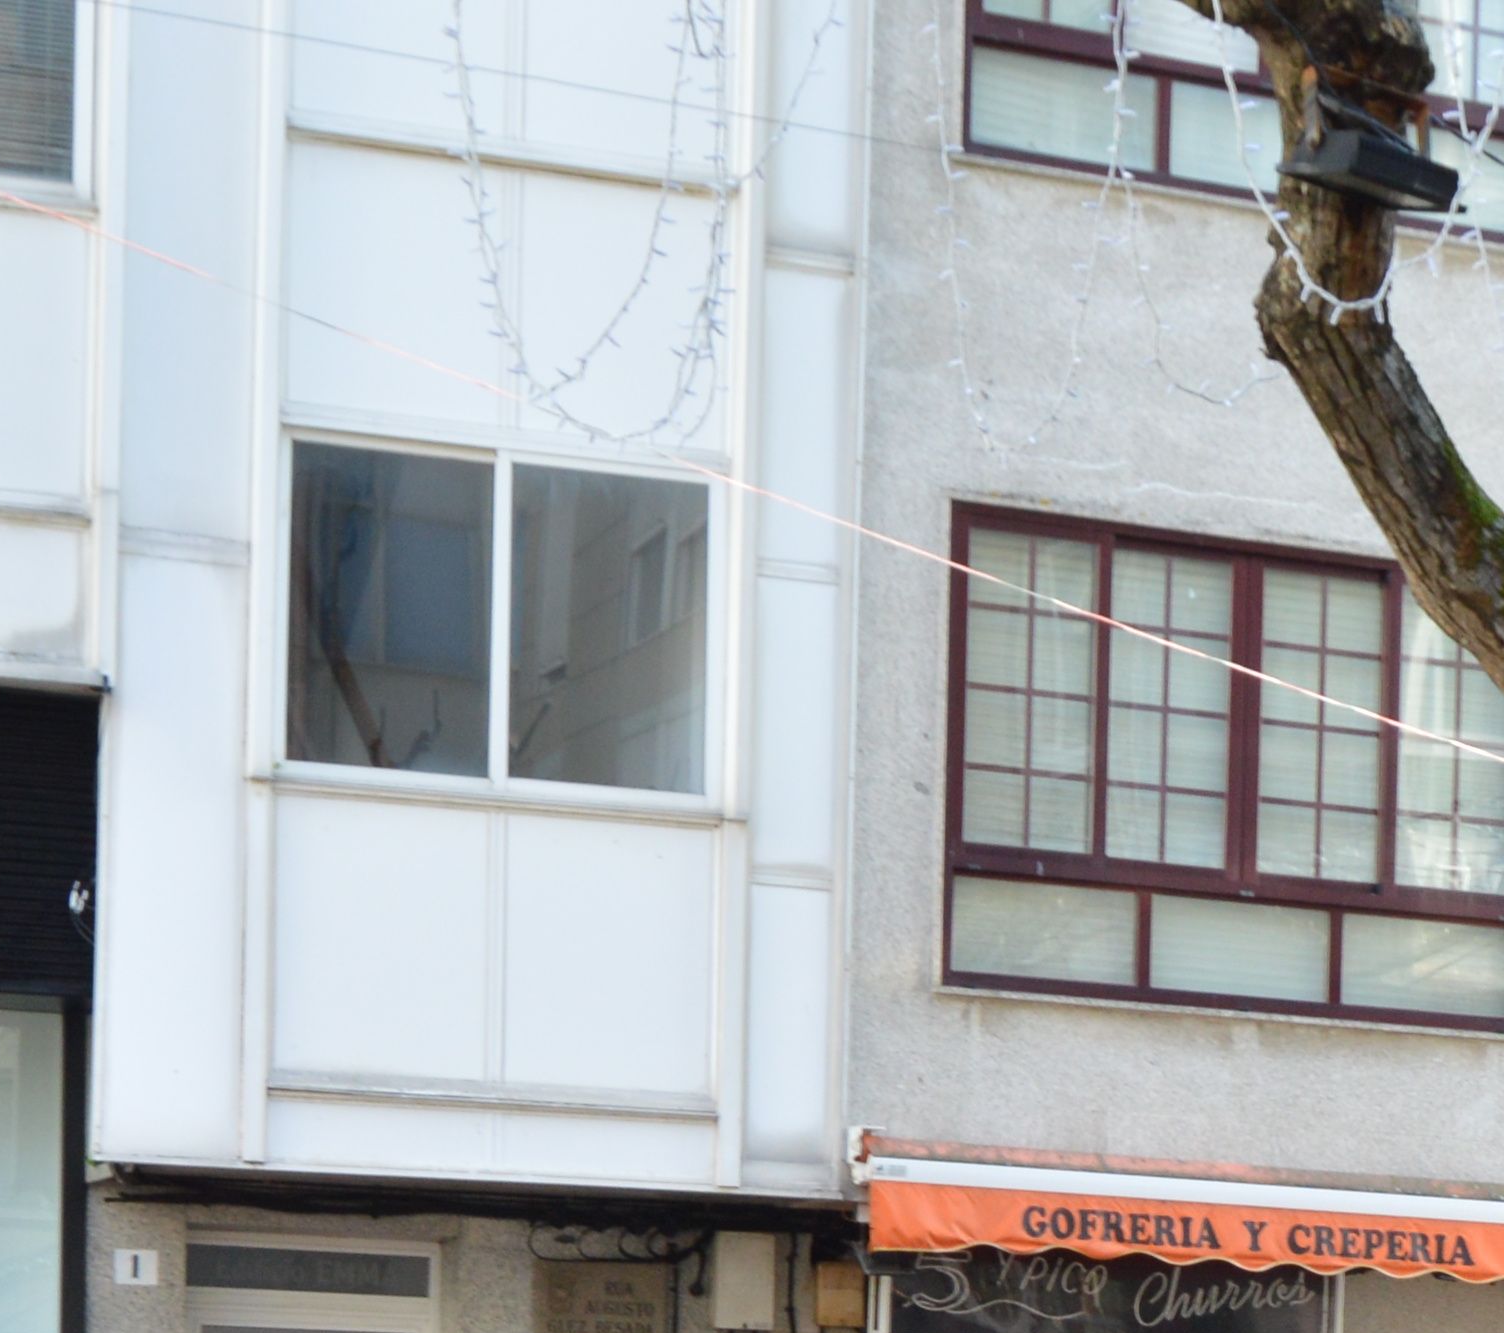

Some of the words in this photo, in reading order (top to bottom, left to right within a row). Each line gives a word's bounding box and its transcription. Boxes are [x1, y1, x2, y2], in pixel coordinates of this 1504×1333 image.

[131, 1254, 141, 1279] 1
[1022, 1205, 1222, 1250] GOFRERIA
[1242, 1219, 1267, 1252] Y
[1287, 1223, 1475, 1267] CREPERIA
[1133, 1266, 1315, 1327] Churros
